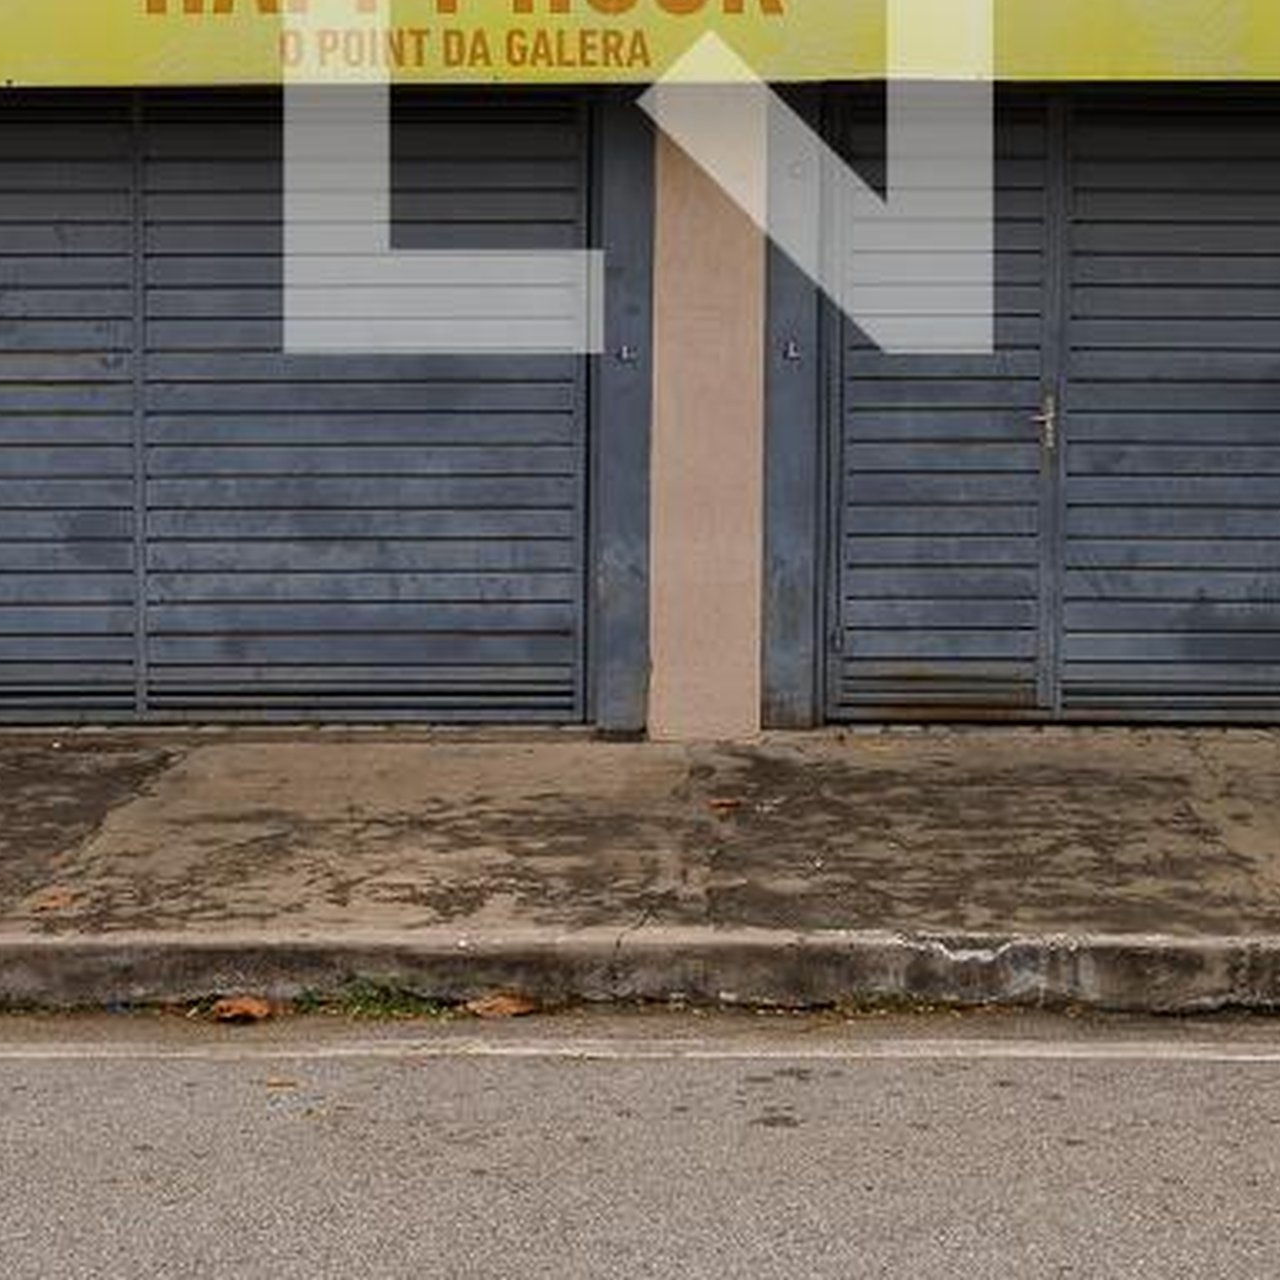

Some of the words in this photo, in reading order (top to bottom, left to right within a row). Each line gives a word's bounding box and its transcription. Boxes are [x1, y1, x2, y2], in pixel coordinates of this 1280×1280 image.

[278, 28, 300, 68] O
[320, 28, 430, 68] POINT
[443, 28, 493, 68] DA
[506, 28, 652, 68] GALERA
